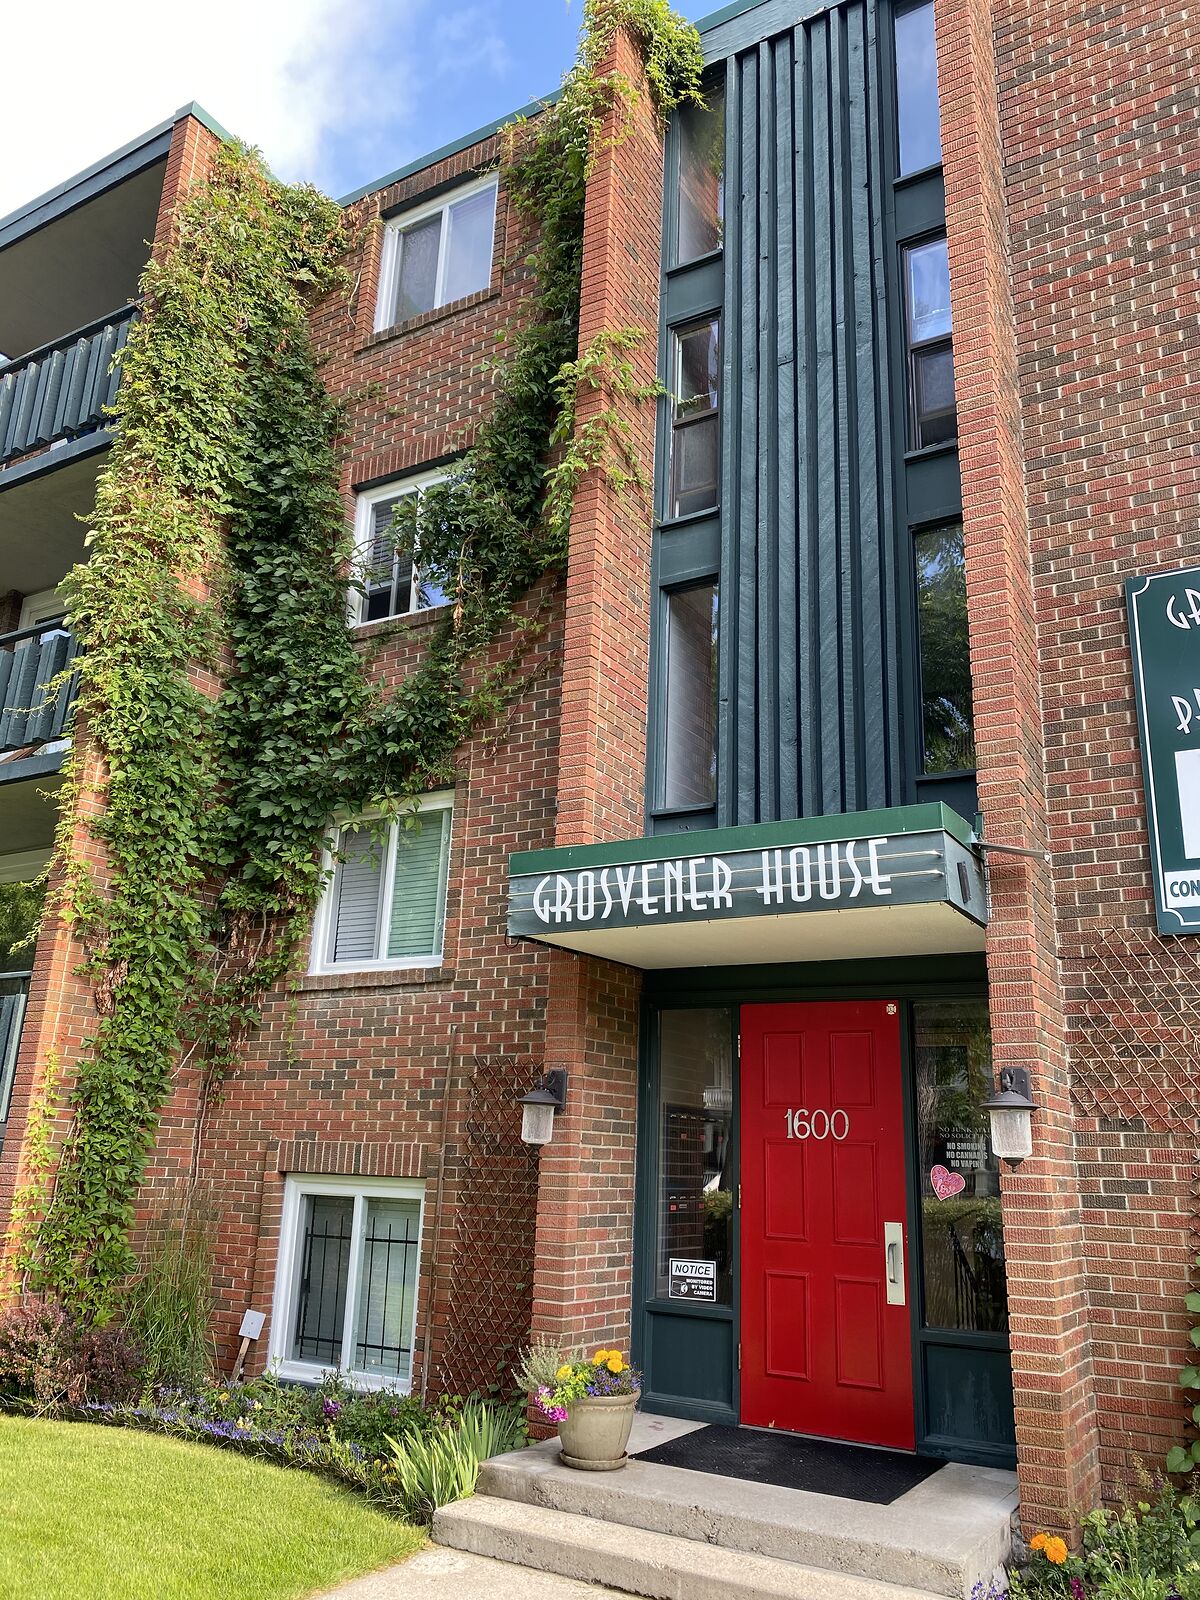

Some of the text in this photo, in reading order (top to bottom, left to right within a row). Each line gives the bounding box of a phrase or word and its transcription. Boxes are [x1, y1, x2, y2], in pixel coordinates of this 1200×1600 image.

[532, 837, 892, 924] GROSVENER HOUSE
[783, 1108, 849, 1140] 1600
[956, 1142, 986, 1150] SMOKING
[956, 1151, 988, 1160] CANNABIS
[675, 1264, 711, 1275] NOTICE
